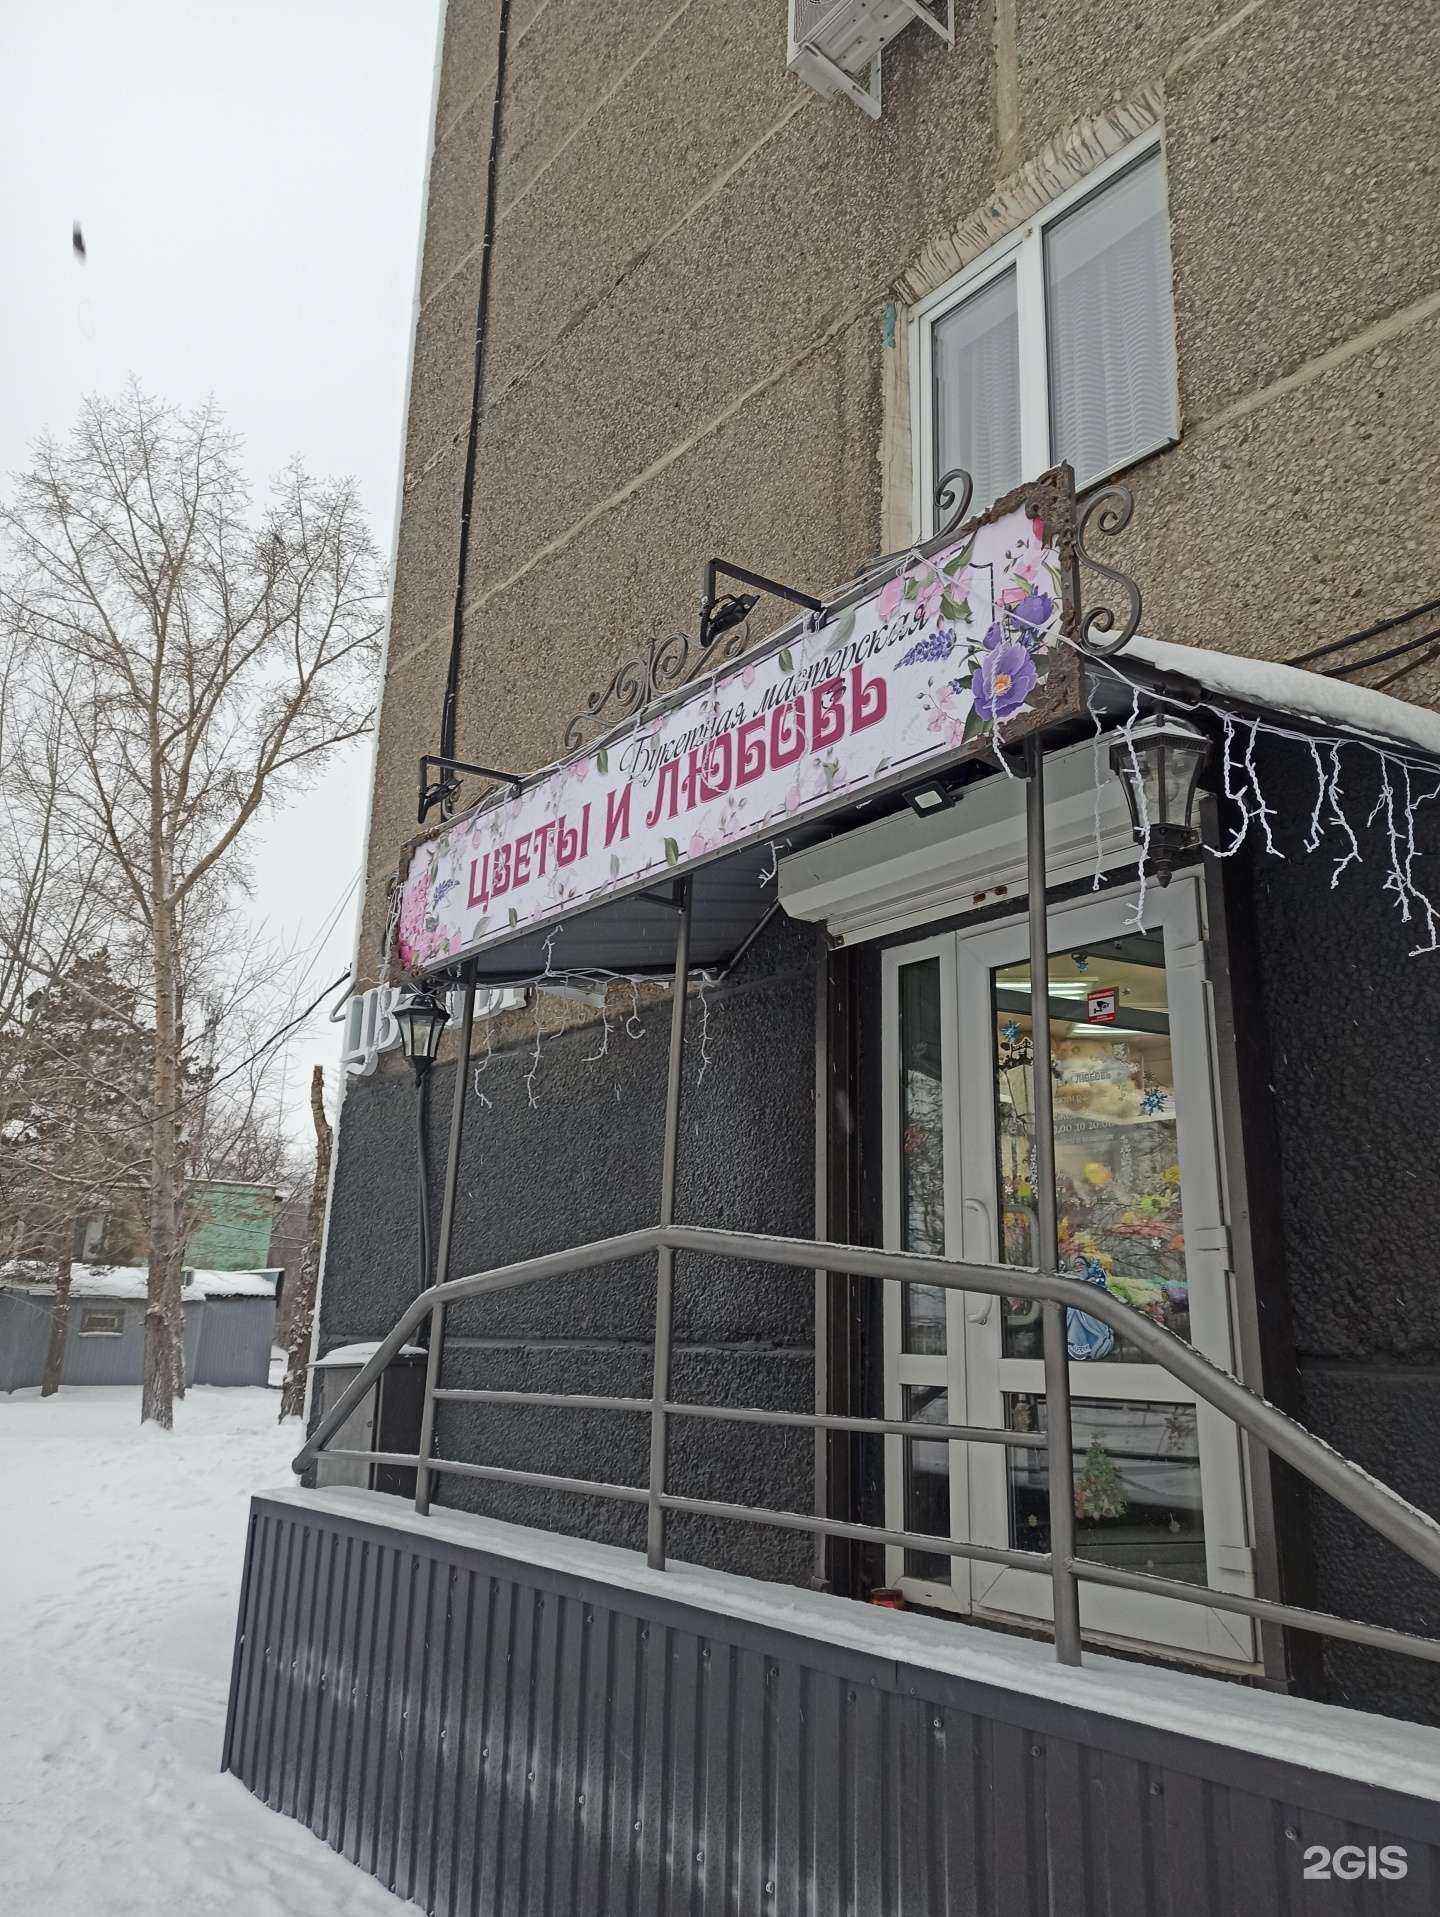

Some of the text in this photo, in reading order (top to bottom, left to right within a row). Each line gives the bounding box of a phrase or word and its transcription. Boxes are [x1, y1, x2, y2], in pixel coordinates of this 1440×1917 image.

[466, 661, 888, 913] ЦВЕТЫ И ЛЮБОВЬ
[619, 603, 928, 788] Букетная мастерская
